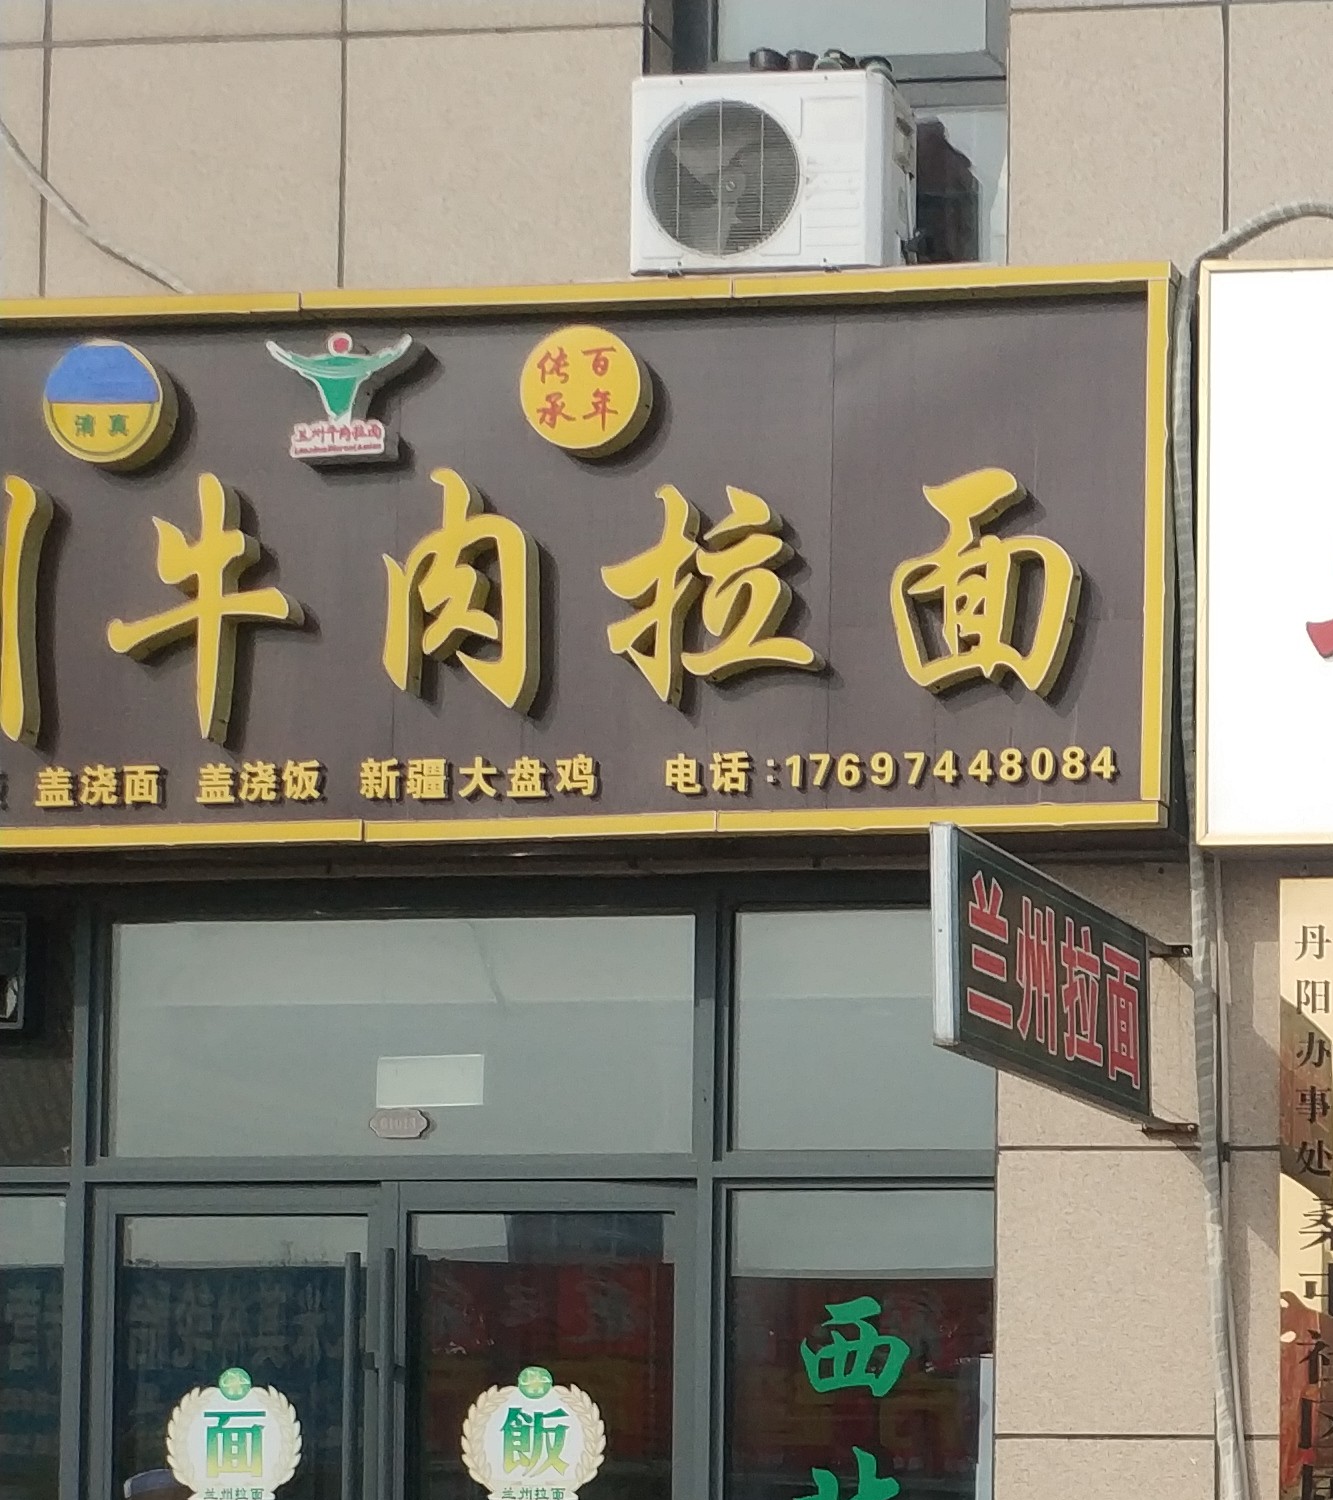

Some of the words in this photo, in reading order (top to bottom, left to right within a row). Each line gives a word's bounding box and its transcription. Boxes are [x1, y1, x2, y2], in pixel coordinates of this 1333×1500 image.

[537, 346, 576, 429] 传承
[581, 346, 618, 431] 百年
[74, 414, 130, 438] 清真
[0, 467, 1078, 742] 牛肉拉面
[35, 765, 161, 807] 盖浇面
[196, 760, 321, 803] 盖浇饭
[359, 753, 599, 800] 新疆大盘鸡
[967, 870, 1141, 1090] 兰州拉面
[1294, 923, 1333, 1178] 丹阳办事处
[203, 1410, 267, 1479] 面
[203, 1486, 266, 1500] 兰州拉面
[501, 1486, 567, 1500] 兰州拉面
